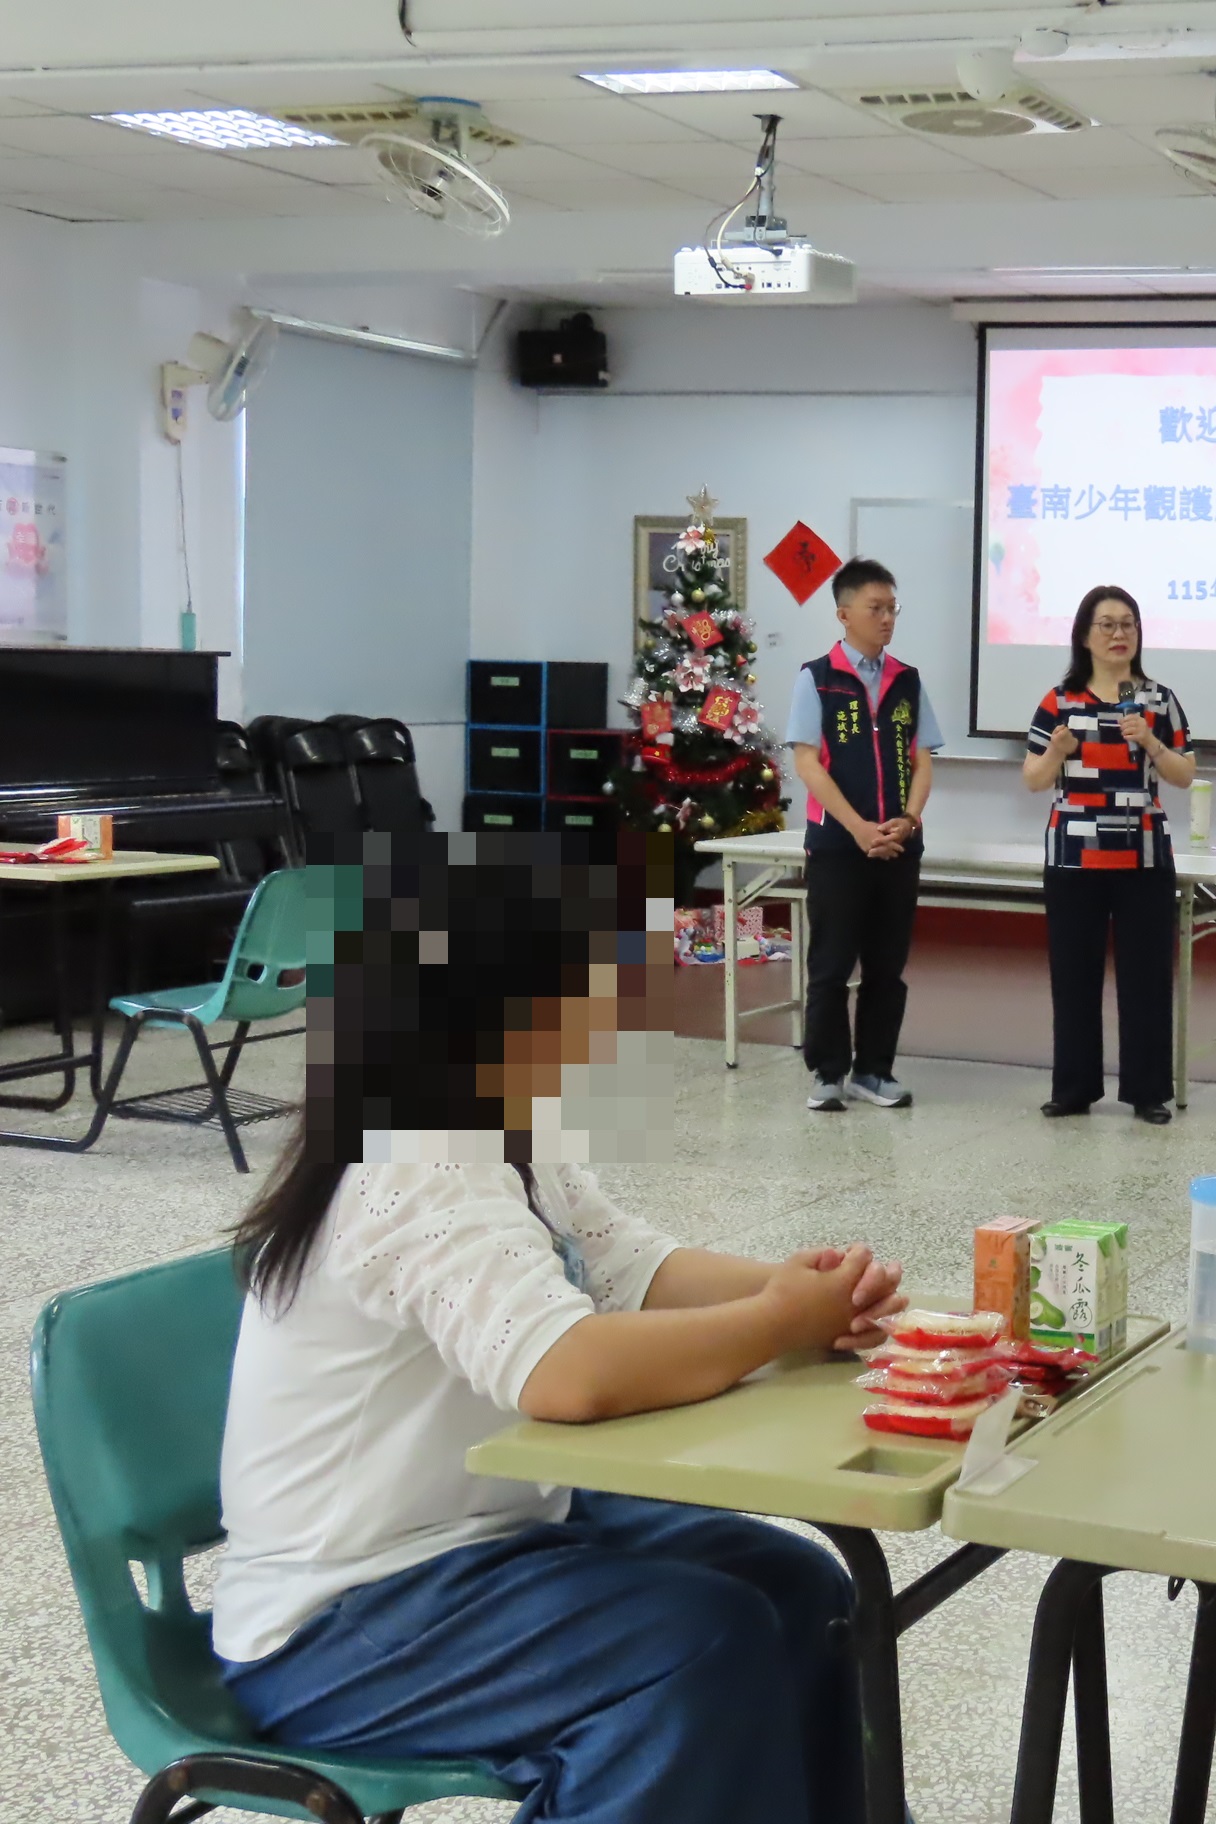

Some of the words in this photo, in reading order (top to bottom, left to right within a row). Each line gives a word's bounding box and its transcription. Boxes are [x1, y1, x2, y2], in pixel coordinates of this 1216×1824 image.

[849, 700, 860, 734] 理事長
[1071, 1251, 1091, 1322] 冬瓜露
